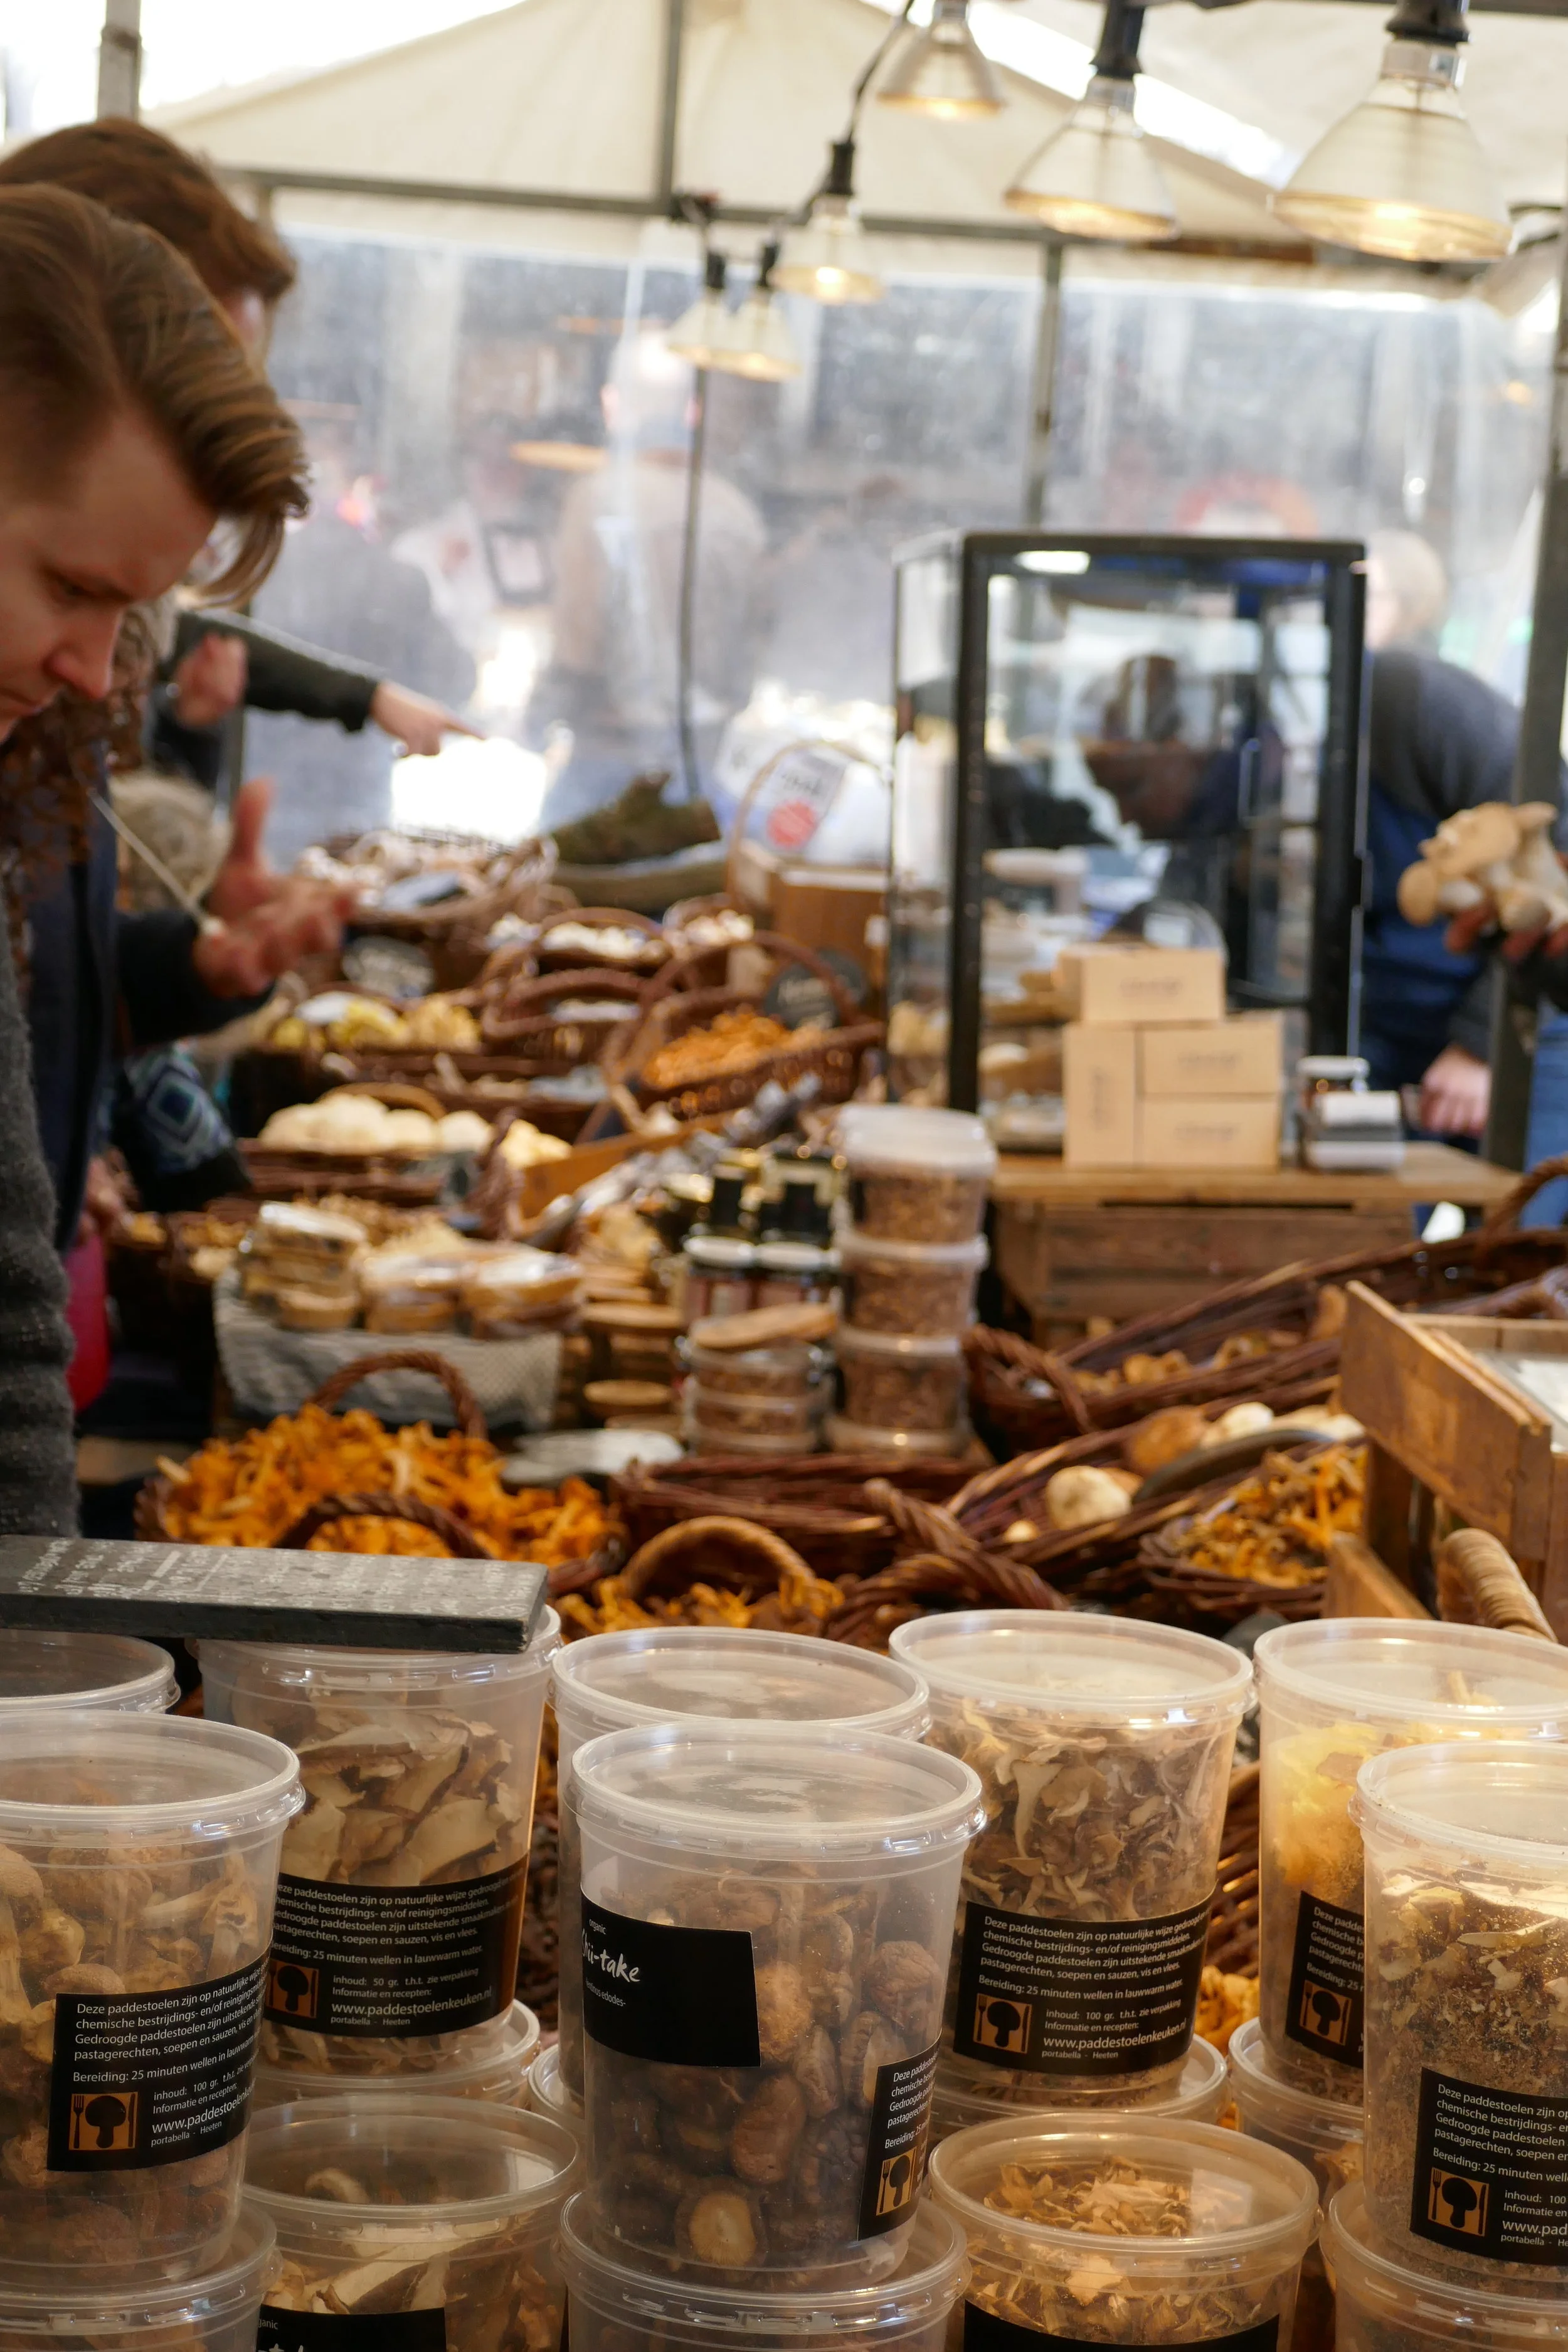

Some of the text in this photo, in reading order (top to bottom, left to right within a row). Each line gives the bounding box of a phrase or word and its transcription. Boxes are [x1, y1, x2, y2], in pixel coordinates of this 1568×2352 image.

[277, 1883, 292, 1894] eze
[294, 1888, 358, 1904] paddestoelen
[360, 1895, 376, 1905] zijn
[379, 1899, 393, 1907] op
[395, 1894, 443, 1905] natuurlijke
[445, 1891, 467, 1900] wijze
[275, 1896, 317, 1912] hemische
[319, 1904, 379, 1919] bestrijdings-
[381, 1909, 406, 1919] en/of
[1314, 1907, 1333, 1922] Deze
[275, 1909, 460, 1933] edroogde paddestoelen zijn uitstekende
[589, 1919, 607, 1935] organic
[985, 1916, 1007, 1929] Deze
[1009, 1924, 1074, 1940] paddestoelen
[1076, 1932, 1093, 1942] zijn
[1095, 1934, 1108, 1942] op
[1110, 1929, 1154, 1940] natuurlijke
[1156, 1926, 1173, 1937] wijze
[1312, 1920, 1355, 1944] chemische
[342, 1935, 377, 1946] soepen
[395, 1934, 429, 1944] sauzen,
[431, 1933, 443, 1942] vis
[983, 1930, 1032, 1948] chemische
[1034, 1939, 1094, 1955] bestrijdings-
[1096, 1944, 1120, 1954] en/of
[1311, 1931, 1357, 1956] Gedroogde
[313, 1950, 324, 1959] 25
[327, 1952, 367, 1963] minuten
[369, 1955, 401, 1964] wellen
[403, 1956, 412, 1964] in
[415, 1951, 460, 1963] lauwwarm
[982, 1942, 1166, 1969] Gedroogde paddestoelen zijn uitstekende
[333, 1975, 367, 1986] inhoud:
[388, 1979, 399, 1988] gr.
[427, 1976, 438, 1984] zie
[440, 1968, 479, 1982] verpakking
[981, 1957, 1054, 1978] pastagerechten,
[1057, 1970, 1091, 1981] soepen
[1108, 1969, 1139, 1980] sauzen,
[1141, 1968, 1151, 1976] vis
[1153, 1967, 1162, 1975] en
[1306, 1962, 1347, 1988] Bereiding:
[1347, 1981, 1359, 1991] 25
[77, 2003, 105, 2014] Deze
[108, 1999, 179, 2015] paddestoelen
[181, 1994, 198, 2007] zijn
[199, 1992, 211, 2003] op
[213, 1976, 248, 1998] natuurlijke
[332, 1987, 378, 1998] Informatie
[393, 1988, 432, 1999] recepten:
[978, 1974, 1025, 1994] Bereiding:
[1027, 1985, 1038, 1994] 25
[1041, 1988, 1081, 1999] minuten
[1083, 1990, 1113, 2000] wellen
[1115, 1990, 1123, 1999] in
[1125, 1984, 1165, 1998] lauwwarm
[331, 1986, 492, 2016] www.paddestoelenkeuken.nl
[1046, 2009, 1080, 2020] inhoud:
[1104, 2012, 1115, 2021] gr.
[1139, 2008, 1150, 2017] zie
[1150, 1998, 1182, 2014] verpakking
[75, 2033, 137, 2046] Gedroogde
[140, 2023, 205, 2043] paddestoelen
[208, 2018, 221, 2030] zijn
[223, 2000, 256, 2023] uitstekende
[76, 2002, 223, 2029] chemische bestrijdings- en/of
[331, 2016, 371, 2025] portabella
[1045, 2021, 1089, 2032] Informatie
[1103, 2021, 1139, 2032] recepten:
[75, 2047, 161, 2062] pastagerechten,
[163, 2040, 198, 2053] soepen
[199, 2037, 210, 2045] en
[212, 2026, 238, 2043] sauzen,
[245, 2015, 253, 2026] en
[1044, 2018, 1187, 2050] www.paddestoelenkeuken.nl
[73, 2072, 129, 2084] Bereiding:
[132, 2070, 144, 2080] 25
[147, 2063, 188, 2078] minuten
[190, 2057, 217, 2070] wellen
[219, 2053, 225, 2062] in
[226, 2035, 254, 2058] lauwwarm
[1042, 2049, 1118, 2059] portabella Heeten
[891, 2079, 923, 2097] chemische
[893, 2070, 910, 2082] Deze
[153, 2082, 238, 2114] Informatie en recepten:
[154, 2087, 187, 2100] inhoud:
[193, 2082, 207, 2092] 100
[209, 2079, 219, 2089] gr.
[1438, 2083, 1461, 2099] Deze
[1463, 2094, 1534, 2115] paddestoelen
[1536, 2107, 1555, 2119] zijn
[889, 2092, 923, 2112] Gedroogde
[1437, 2099, 1556, 2132] chemische bestrijdings-
[151, 2121, 222, 2148] portabella Heeten
[885, 2129, 915, 2149] Bereiding:
[916, 2124, 922, 2136] 25
[1436, 2112, 1565, 2146] Gedroogde paddestoelen
[1434, 2128, 1555, 2161] pastagerechten, soepen
[1433, 2146, 1543, 2181] Bereiding: 25 minuten
[1505, 2190, 1566, 2204] inhoud: 100
[1503, 2202, 1554, 2217] Informatie
[1501, 2234, 1545, 2245] portabella
